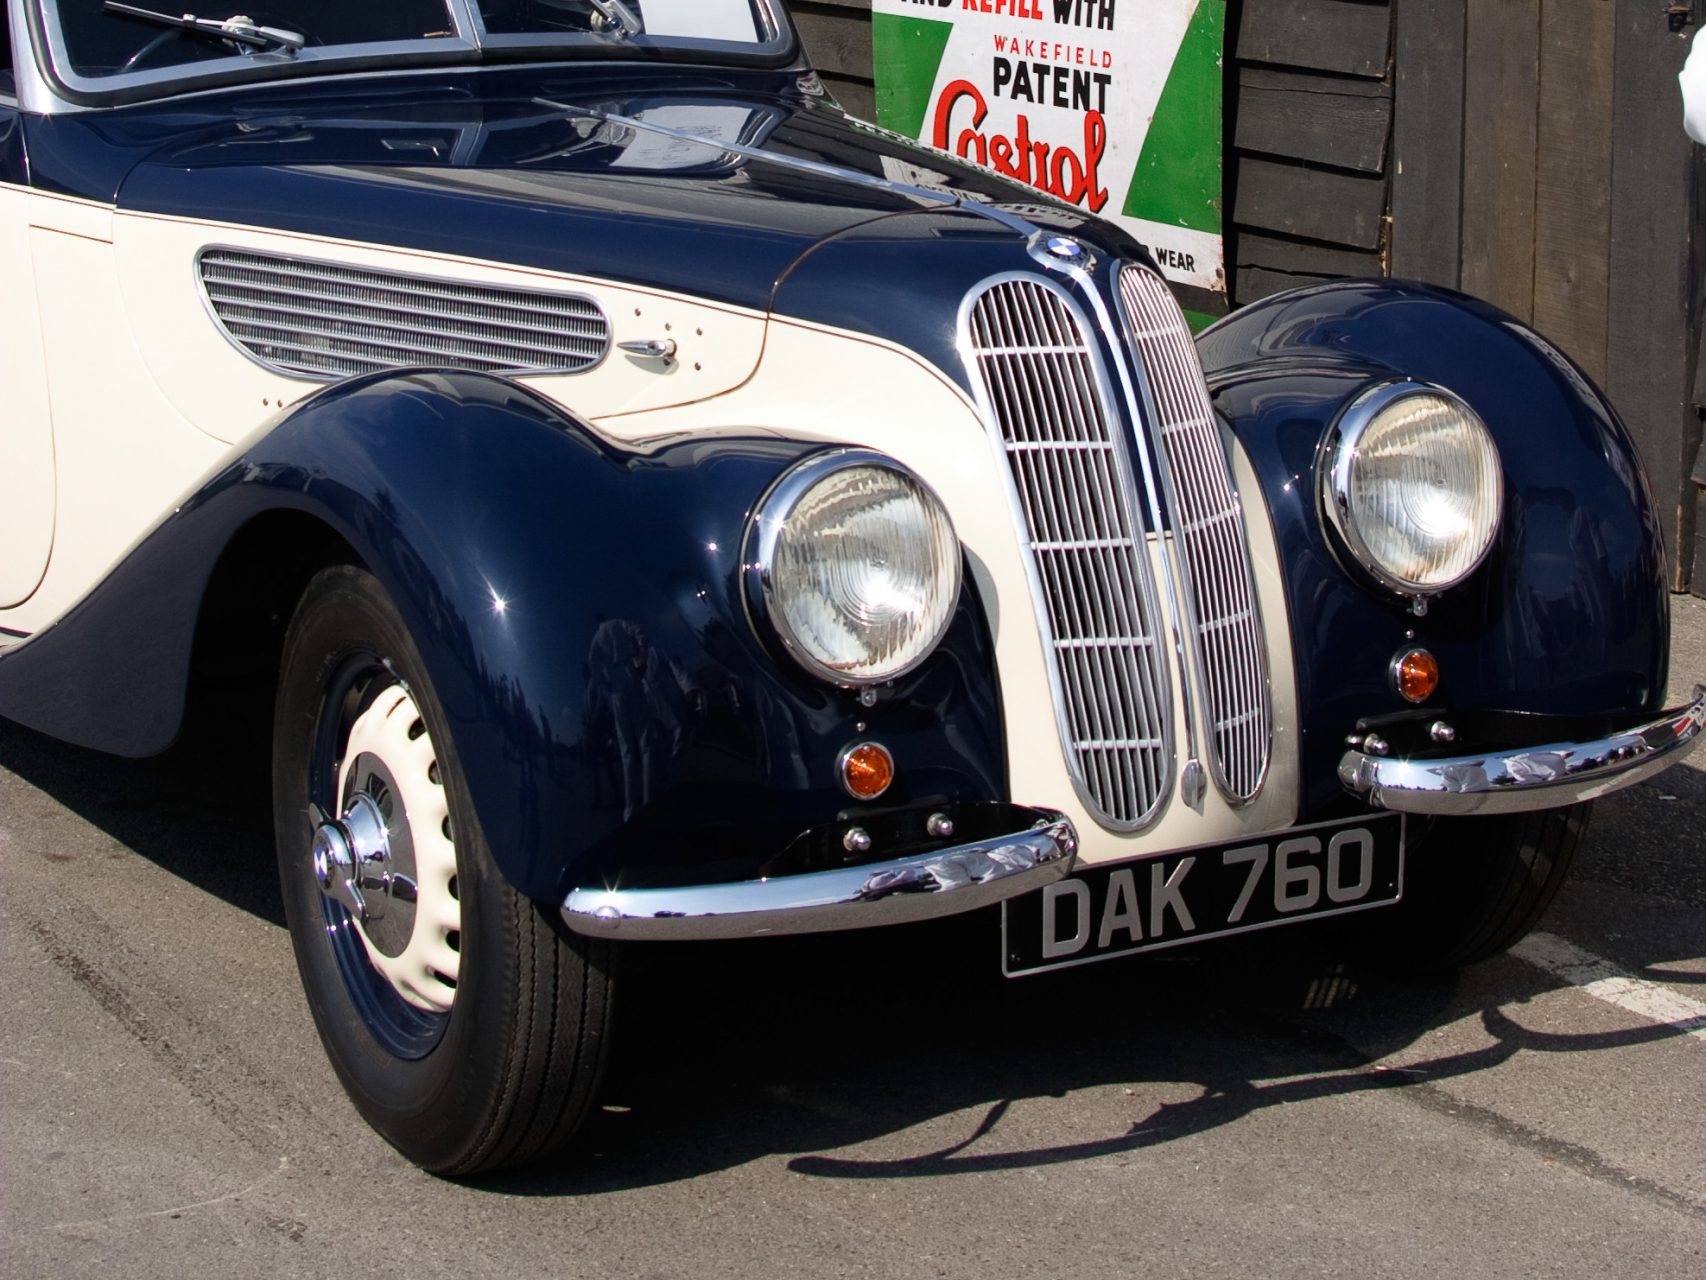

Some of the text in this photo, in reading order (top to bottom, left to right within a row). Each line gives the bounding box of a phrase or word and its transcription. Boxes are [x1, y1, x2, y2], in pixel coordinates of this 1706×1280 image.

[993, 34, 1112, 69] WAKEFIELD
[993, 56, 1111, 115] PATENT
[1155, 247, 1196, 273] WEAR
[1042, 827, 1375, 959] DAK 760
